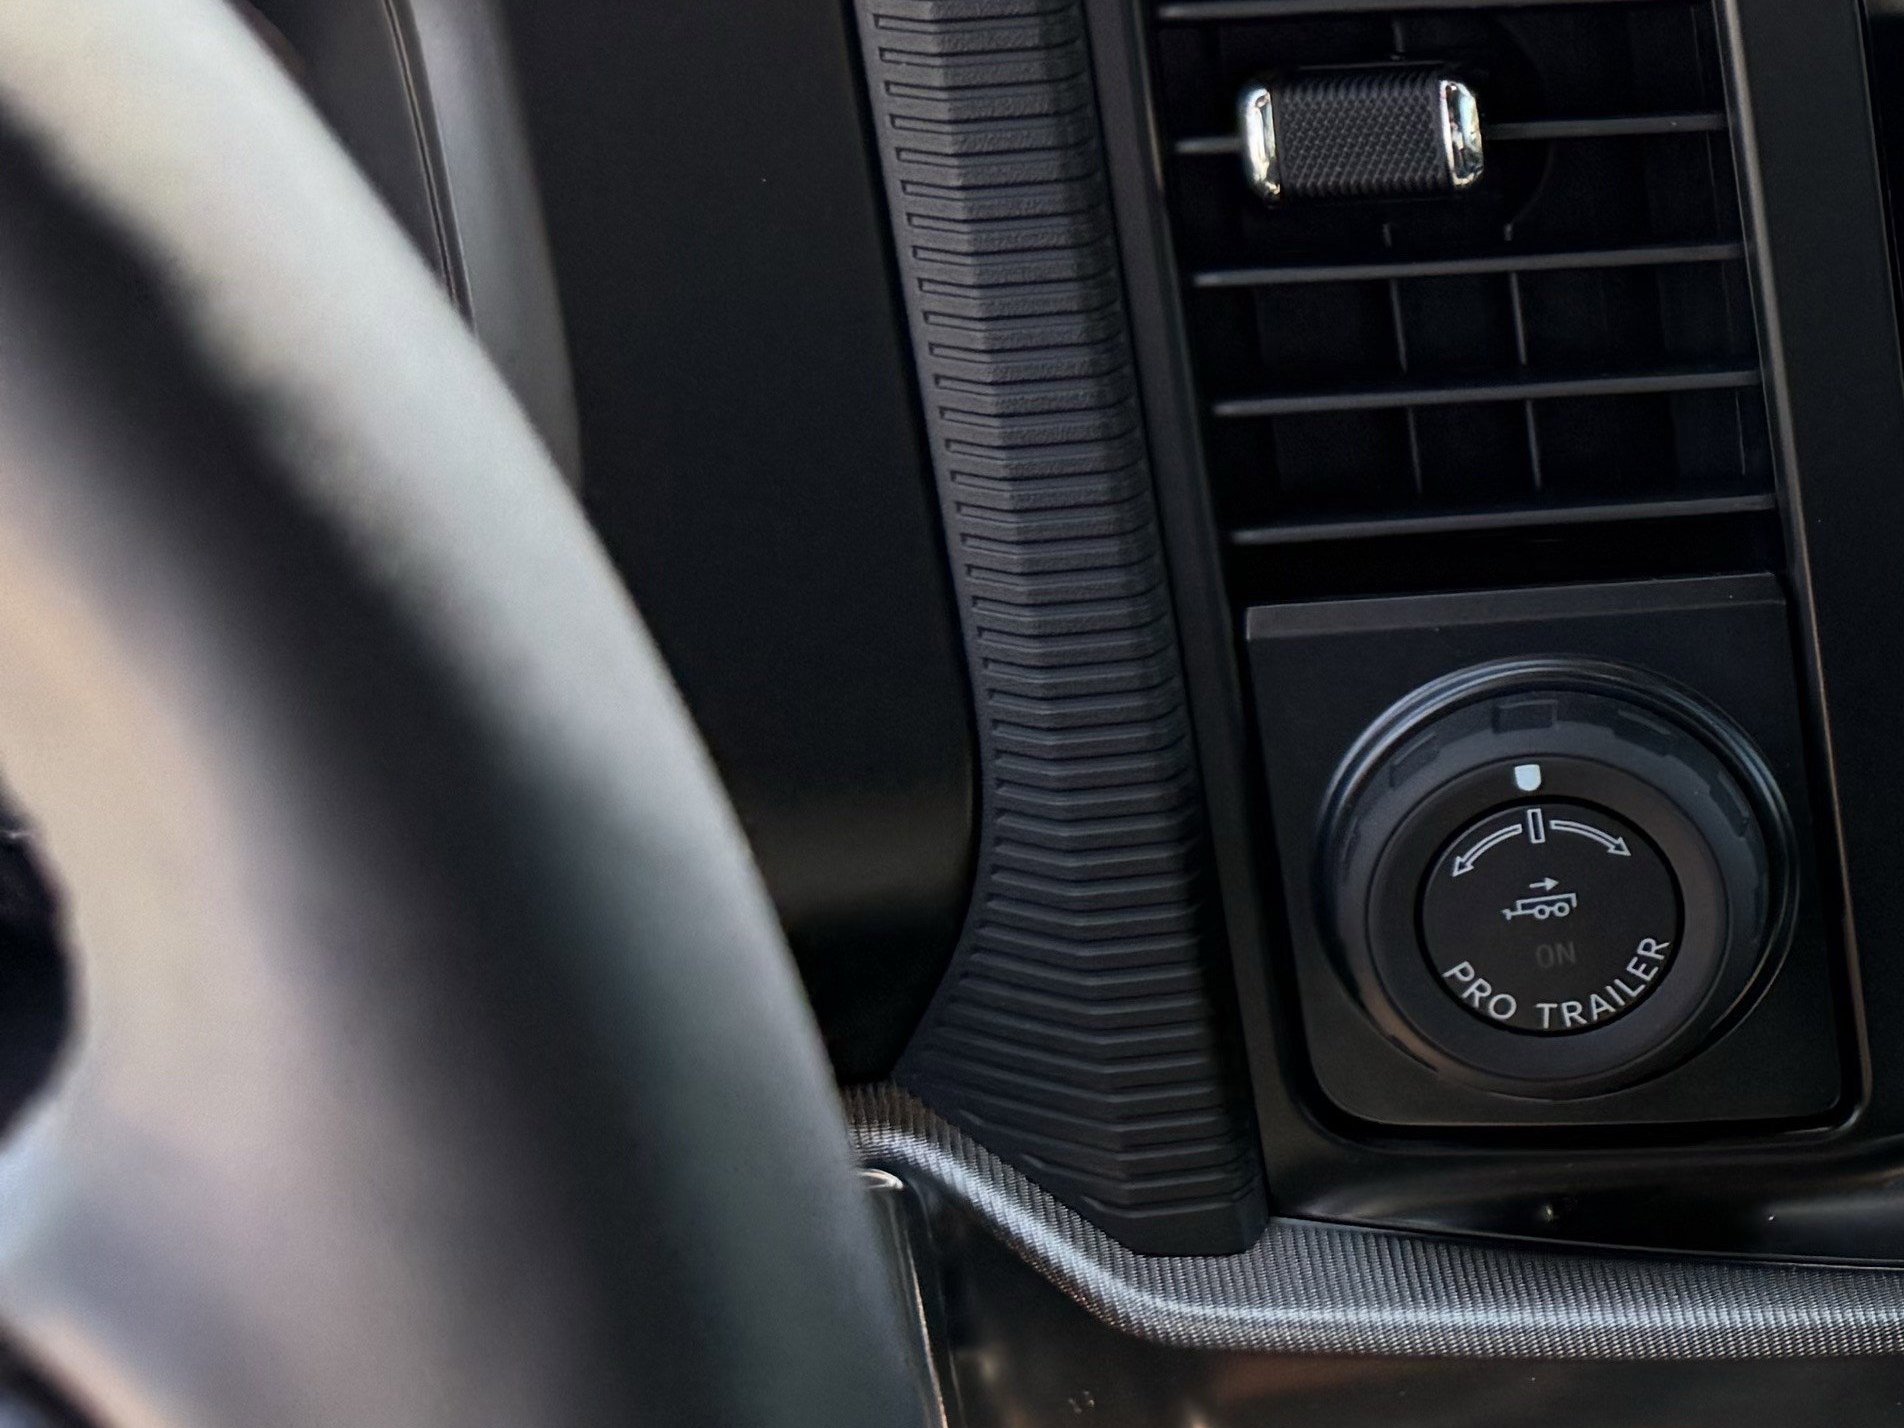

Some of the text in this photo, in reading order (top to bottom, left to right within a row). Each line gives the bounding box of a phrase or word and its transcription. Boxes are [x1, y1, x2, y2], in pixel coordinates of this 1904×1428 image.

[1443, 937, 1670, 1029] PRO TRAILER
[1535, 941, 1576, 967] ON
